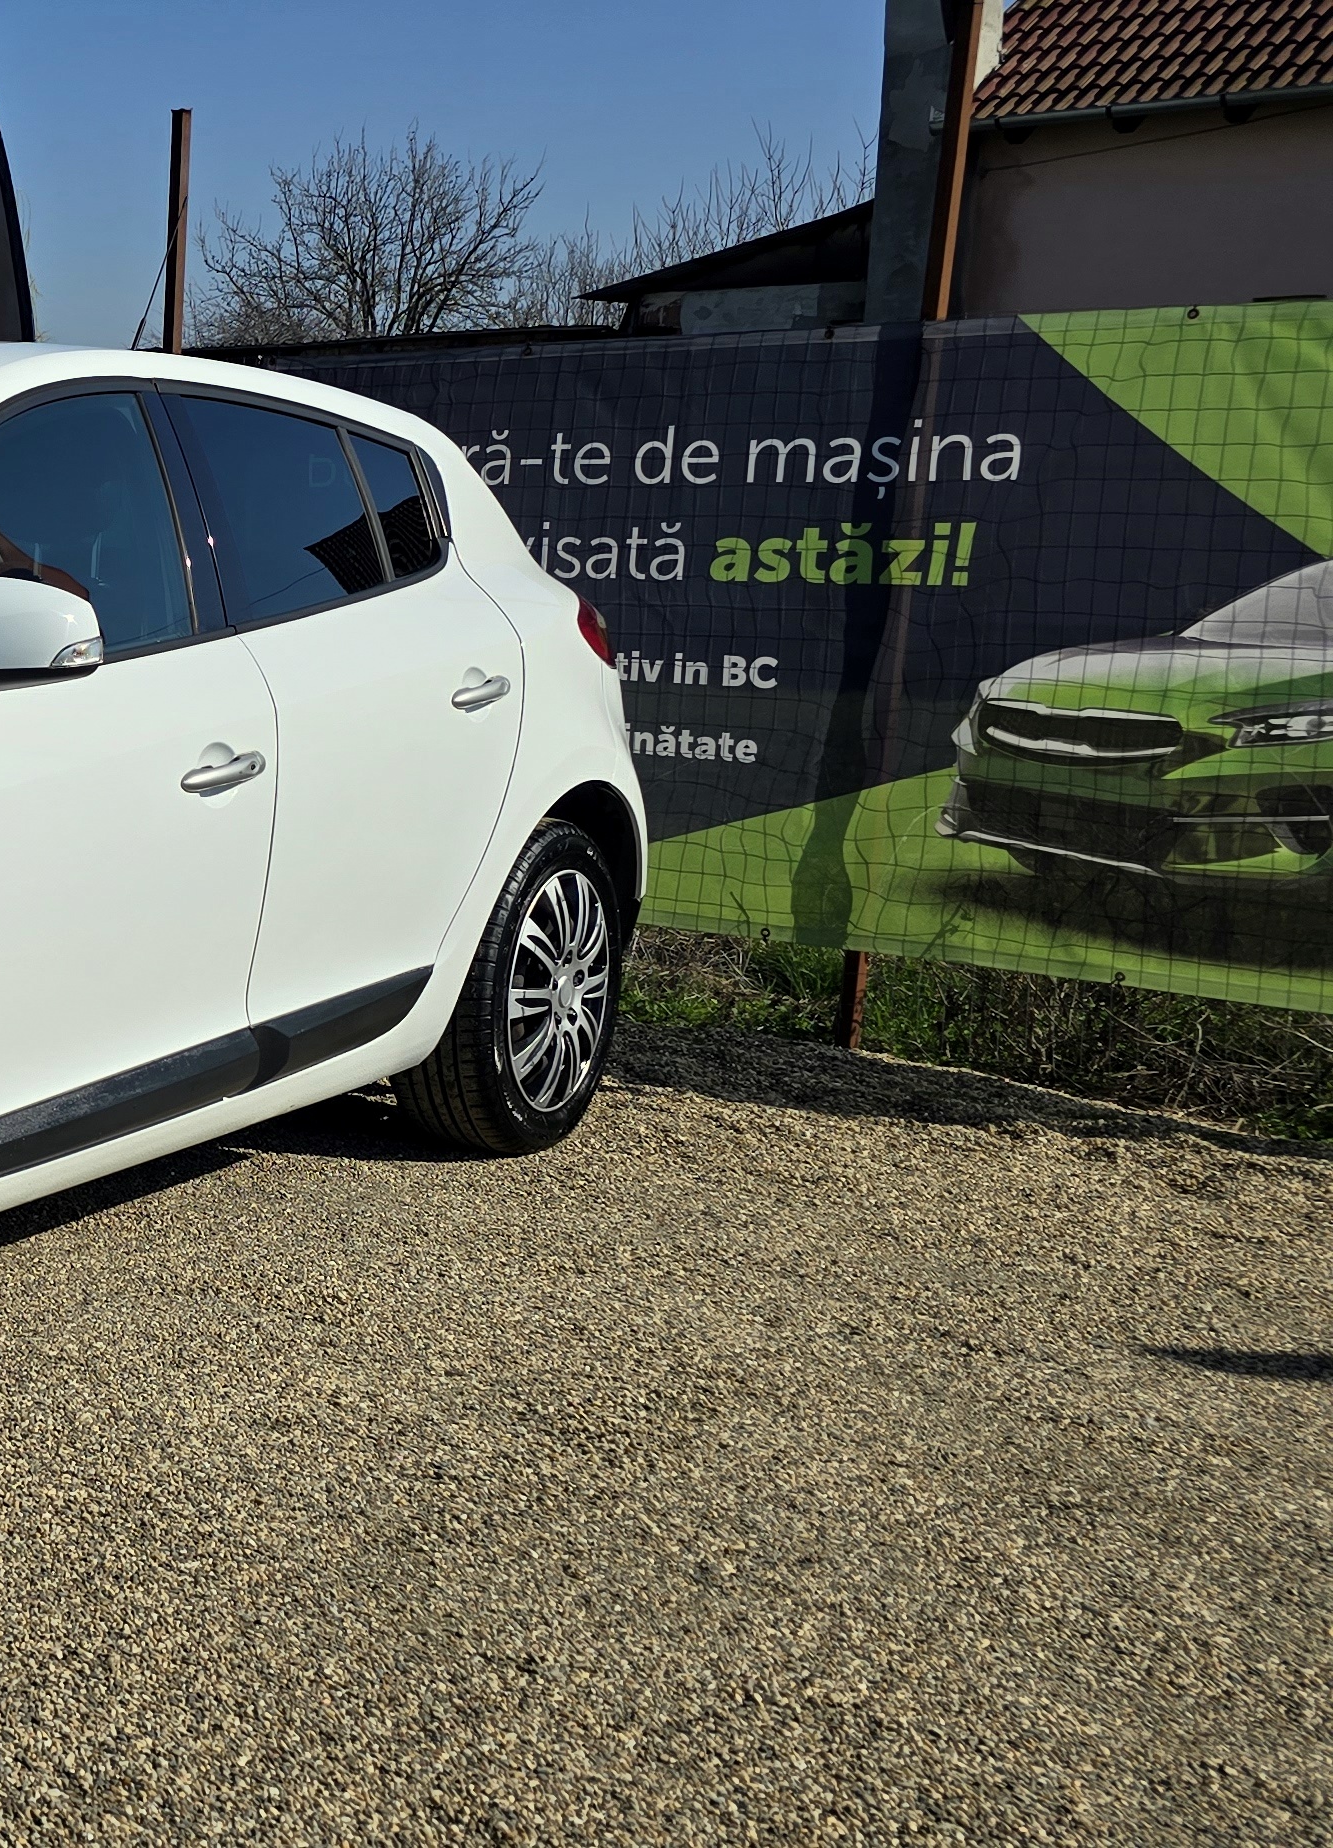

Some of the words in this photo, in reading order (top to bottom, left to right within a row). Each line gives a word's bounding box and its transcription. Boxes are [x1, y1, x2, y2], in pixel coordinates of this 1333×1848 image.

[634, 425, 720, 484] de
[746, 419, 1022, 499] mașina
[526, 521, 685, 580] isată
[710, 521, 977, 587] astăzi!
[615, 651, 664, 683] tiv
[673, 652, 708, 685] in
[722, 655, 779, 689] BC
